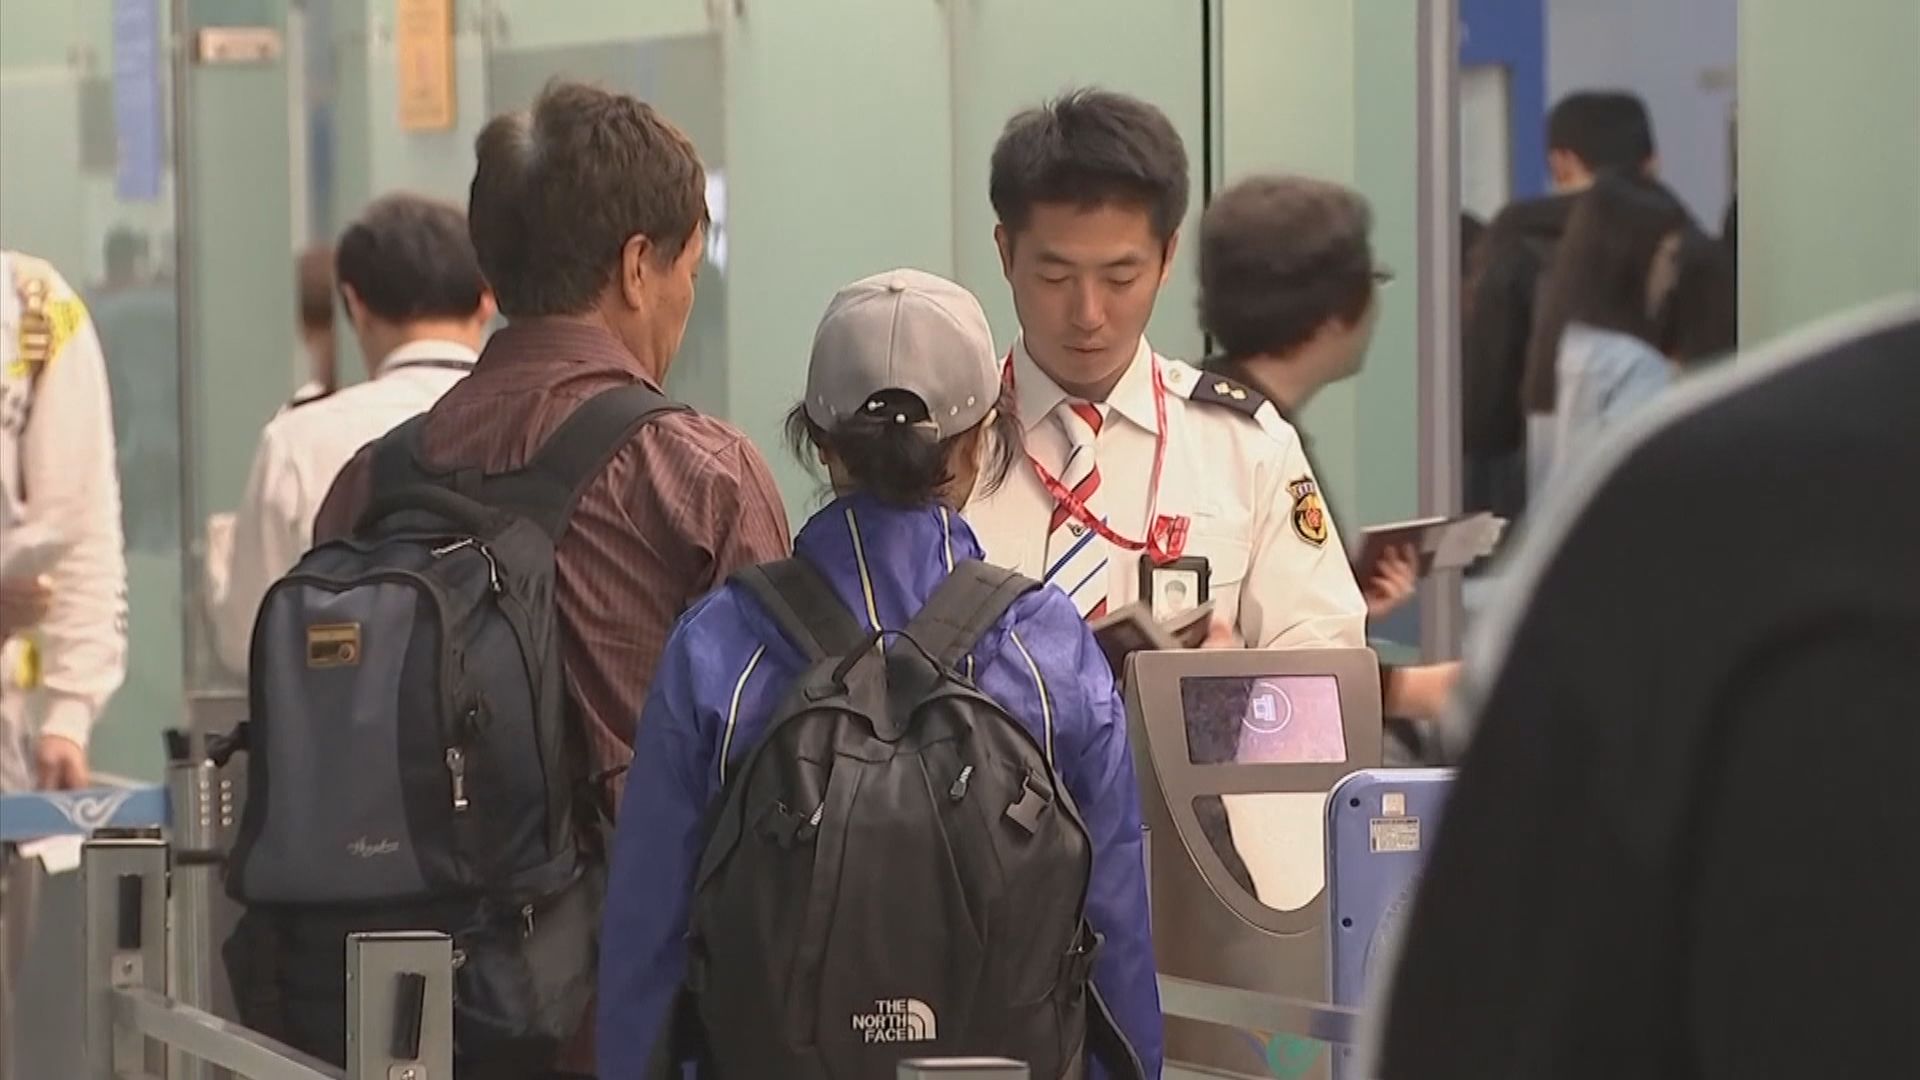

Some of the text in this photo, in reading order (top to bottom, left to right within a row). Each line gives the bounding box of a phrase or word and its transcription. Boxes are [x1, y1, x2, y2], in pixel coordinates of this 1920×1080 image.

[875, 1000, 906, 1013] THE
[853, 1014, 906, 1029] NORTH
[864, 1028, 906, 1043] FACE
